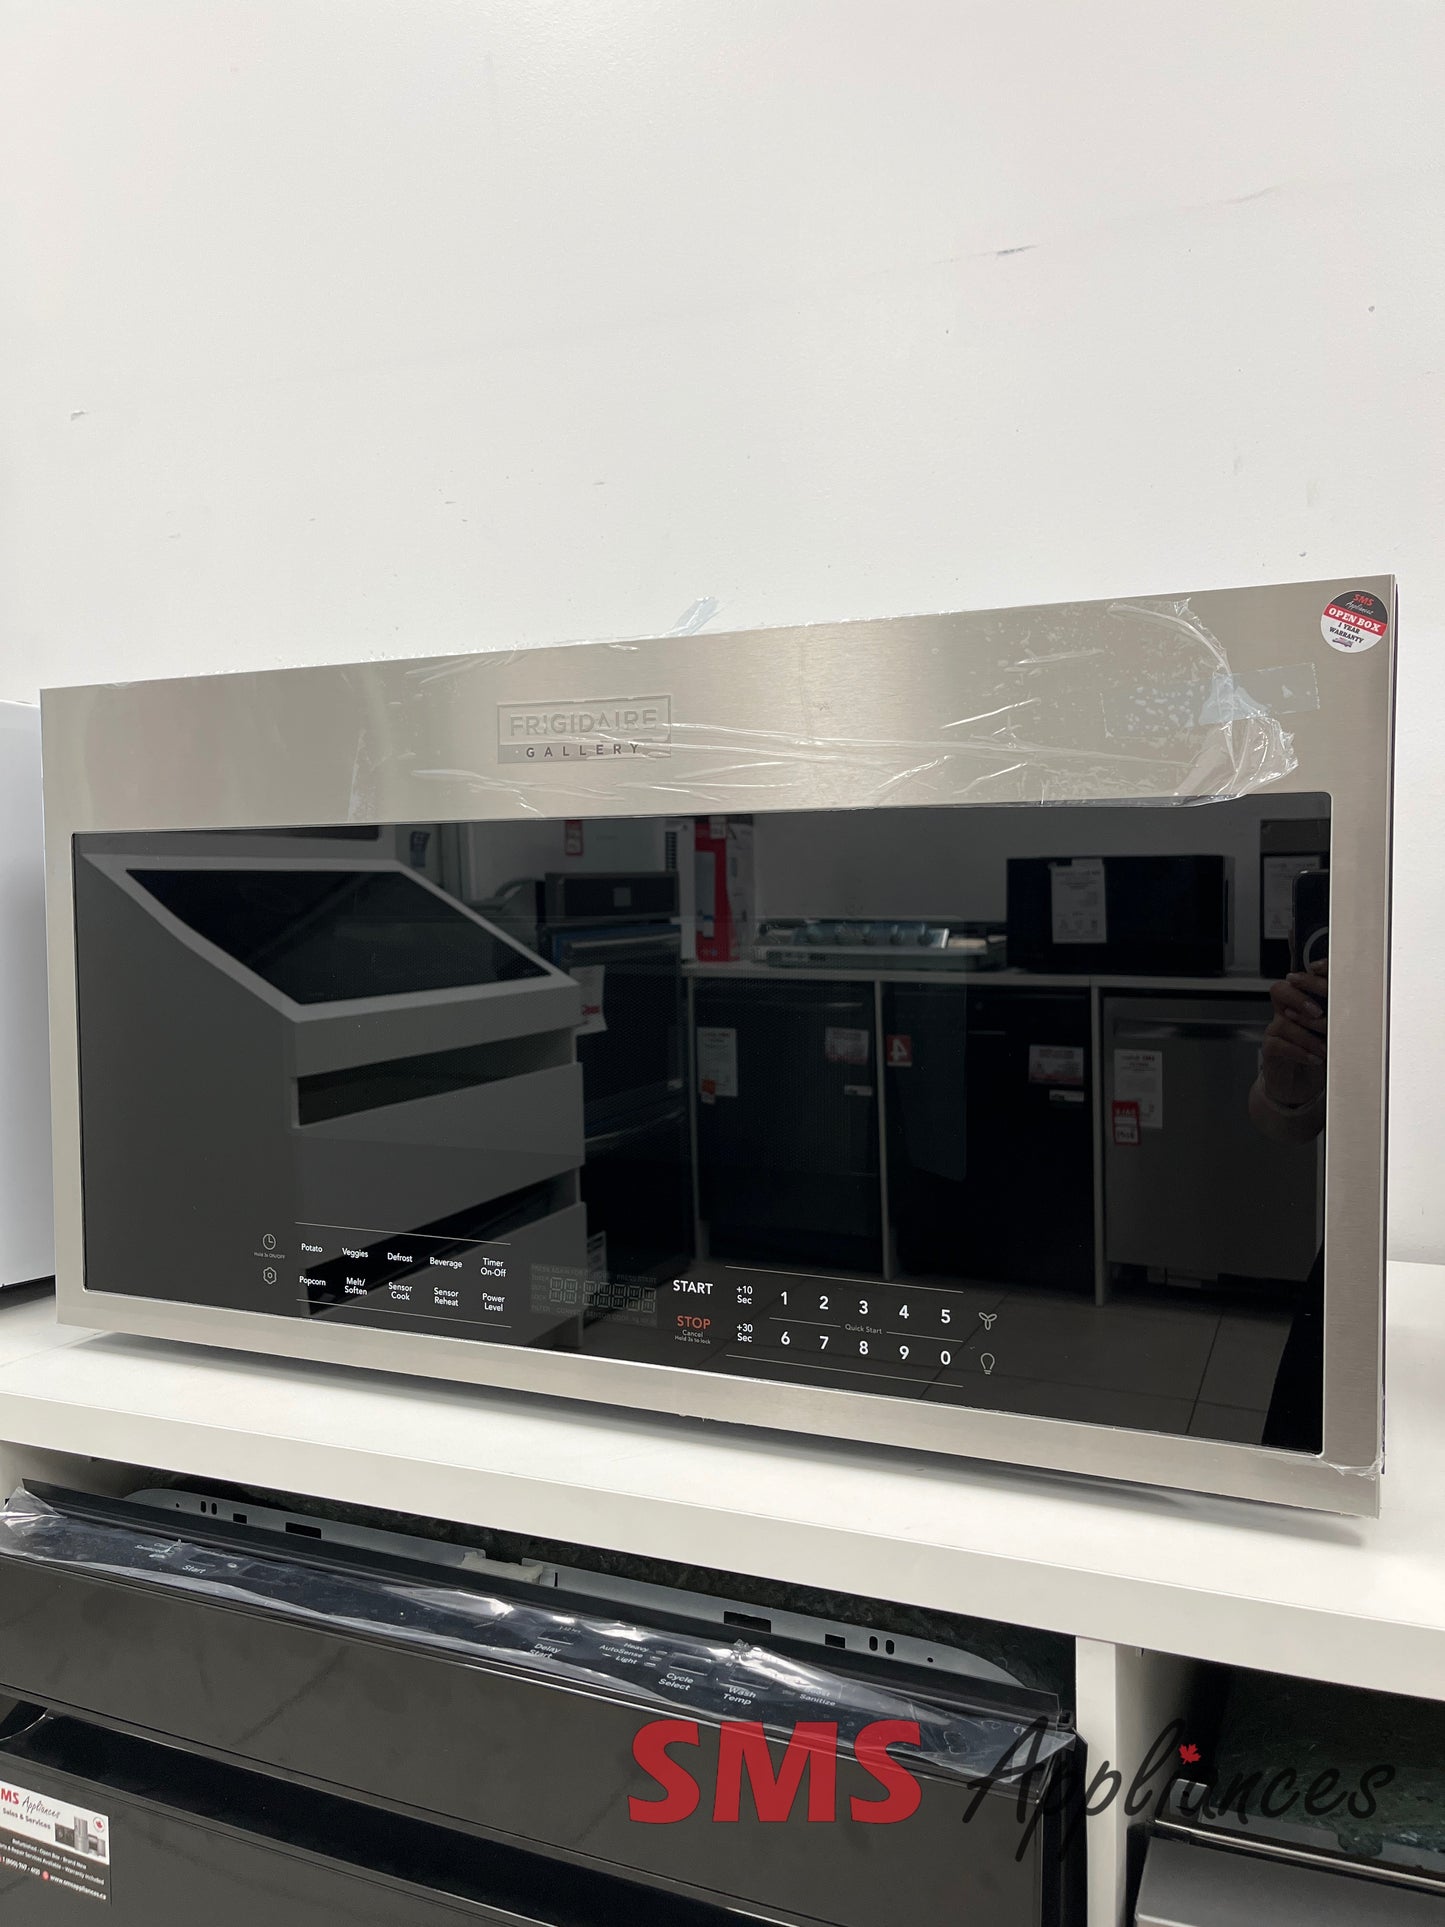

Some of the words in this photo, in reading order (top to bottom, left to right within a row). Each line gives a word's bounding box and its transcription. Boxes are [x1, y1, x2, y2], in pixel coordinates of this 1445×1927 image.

[1353, 593, 1374, 606] SMS
[1328, 607, 1357, 624] OPEN
[1357, 617, 1381, 632] BOX
[1329, 626, 1365, 643] WARRANTY
[1344, 624, 1360, 634] YEAR
[510, 709, 657, 737] FRIGIDAIRE
[526, 743, 639, 758] GALLERY
[301, 1242, 323, 1253] Potato
[342, 1247, 369, 1259] Veggies
[387, 1252, 413, 1263] Defrost
[429, 1256, 463, 1269] Beverage
[482, 1257, 504, 1267] Timer
[480, 1267, 507, 1277] On-Off
[299, 1275, 327, 1286] Popcorn
[346, 1276, 366, 1287] Melt/
[344, 1285, 368, 1296] Soften
[388, 1281, 413, 1292] Sensor
[433, 1287, 459, 1297] Sensor
[673, 1279, 713, 1295] START
[736, 1285, 753, 1294] +10
[391, 1291, 410, 1301] Cook
[434, 1296, 459, 1307] Reheat
[482, 1292, 505, 1303] Power
[737, 1294, 752, 1305] Sec
[484, 1301, 503, 1312] Level
[780, 1291, 788, 1305] 1
[819, 1295, 829, 1310] 2
[859, 1300, 869, 1315] 3
[899, 1304, 910, 1319] 4
[940, 1309, 951, 1324] 5
[676, 1315, 711, 1329] STOP
[682, 1329, 704, 1338] Cancel
[736, 1323, 753, 1333] +30
[844, 1323, 865, 1333] Quick
[865, 1325, 882, 1335] Start
[737, 1332, 753, 1343] Sec
[781, 1331, 791, 1345] 6
[819, 1335, 829, 1350] 7
[859, 1340, 869, 1355] 8
[899, 1345, 910, 1360] 9
[940, 1350, 951, 1365] 0
[182, 1564, 206, 1573] Start
[534, 1643, 561, 1654] Delay
[599, 1645, 643, 1658] AutoSense
[624, 1642, 650, 1653] Heavy
[529, 1649, 553, 1659] Start
[615, 1655, 638, 1665] Light
[666, 1672, 694, 1684] Cycle
[658, 1678, 691, 1691] Select
[728, 1687, 757, 1699] Wash
[723, 1693, 752, 1706] Temp
[799, 1693, 837, 1707] Sanitize
[22, 1796, 60, 1818] Appliances
[3, 1807, 18, 1818] Sales
[25, 1815, 51, 1830] Services
